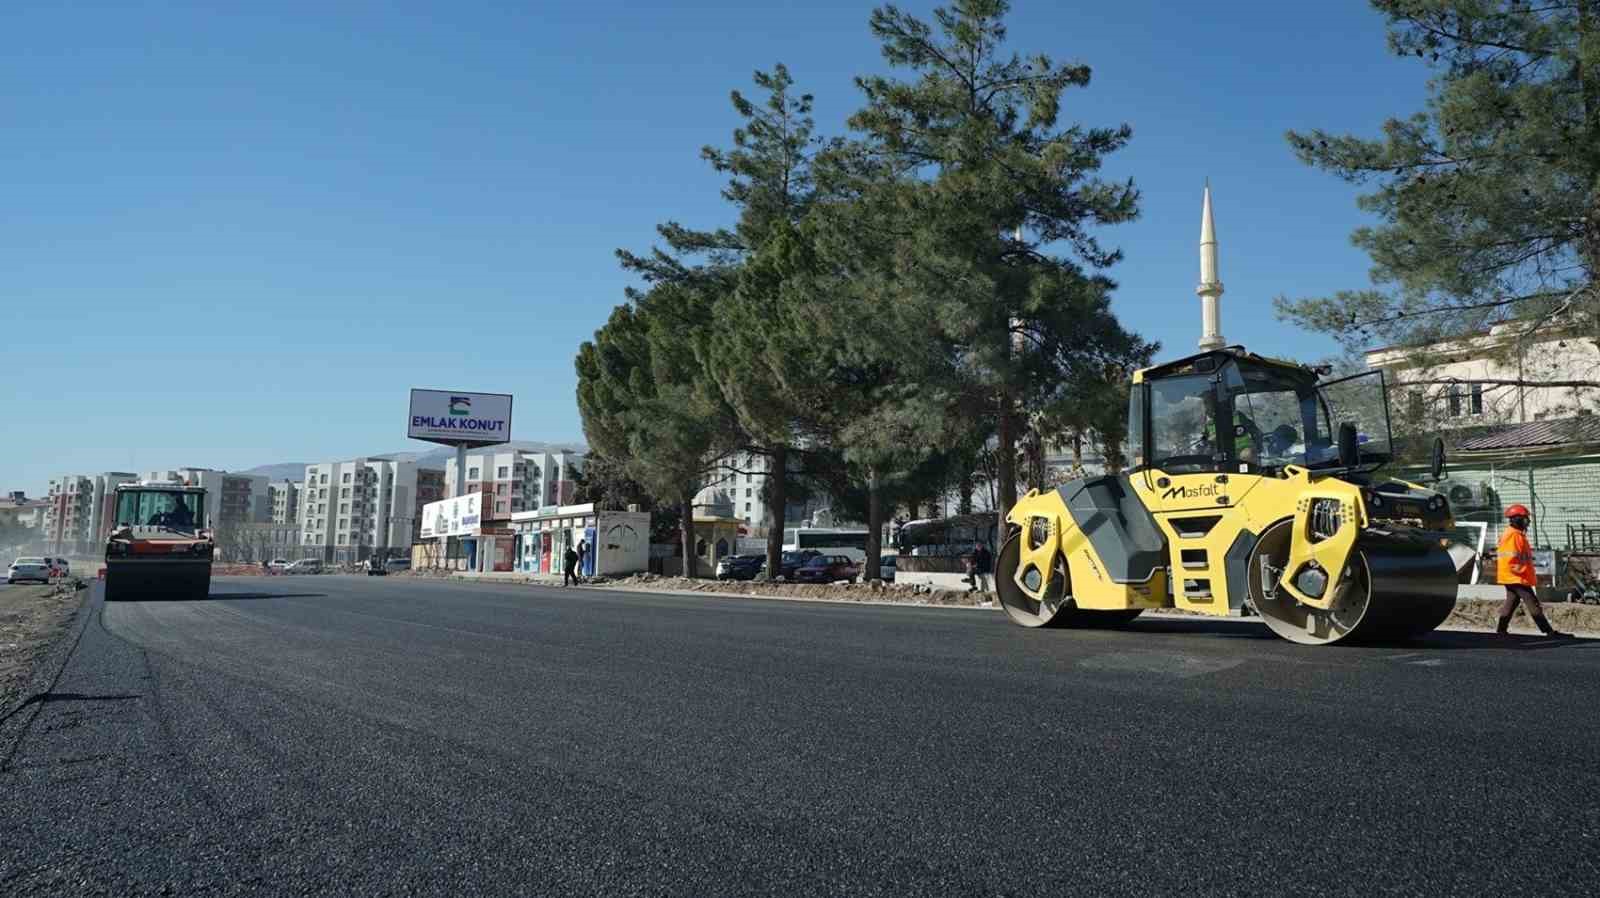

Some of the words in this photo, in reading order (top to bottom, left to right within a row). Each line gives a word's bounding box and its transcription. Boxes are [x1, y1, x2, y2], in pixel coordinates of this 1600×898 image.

[412, 416, 457, 428] EMLAK
[460, 418, 504, 431] KONUT
[1162, 484, 1219, 499] Masfalt
